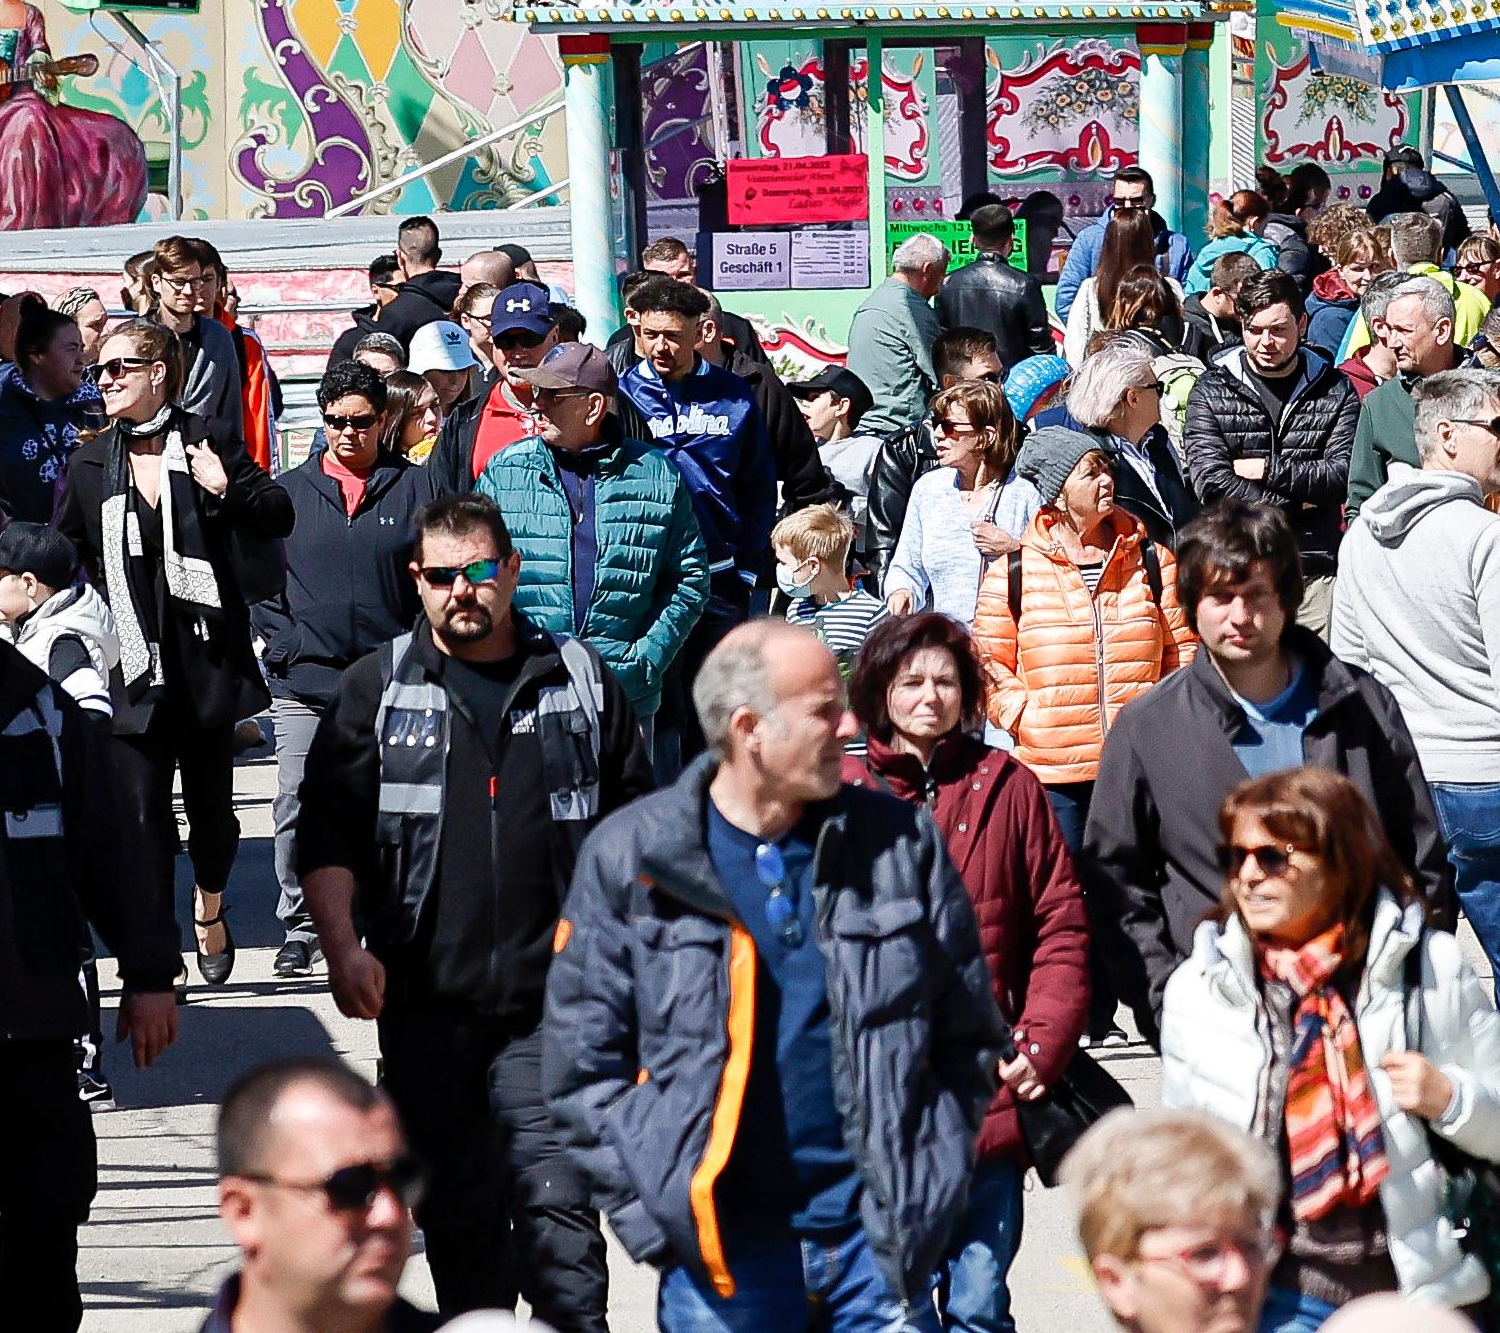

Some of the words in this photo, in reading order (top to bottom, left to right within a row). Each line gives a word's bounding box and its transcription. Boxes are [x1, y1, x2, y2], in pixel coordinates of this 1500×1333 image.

[890, 223, 947, 232] Mittwochs
[726, 242, 767, 255] Straße
[769, 243, 777, 255] 5
[719, 261, 773, 273] Geschäft
[776, 261, 782, 273] 1
